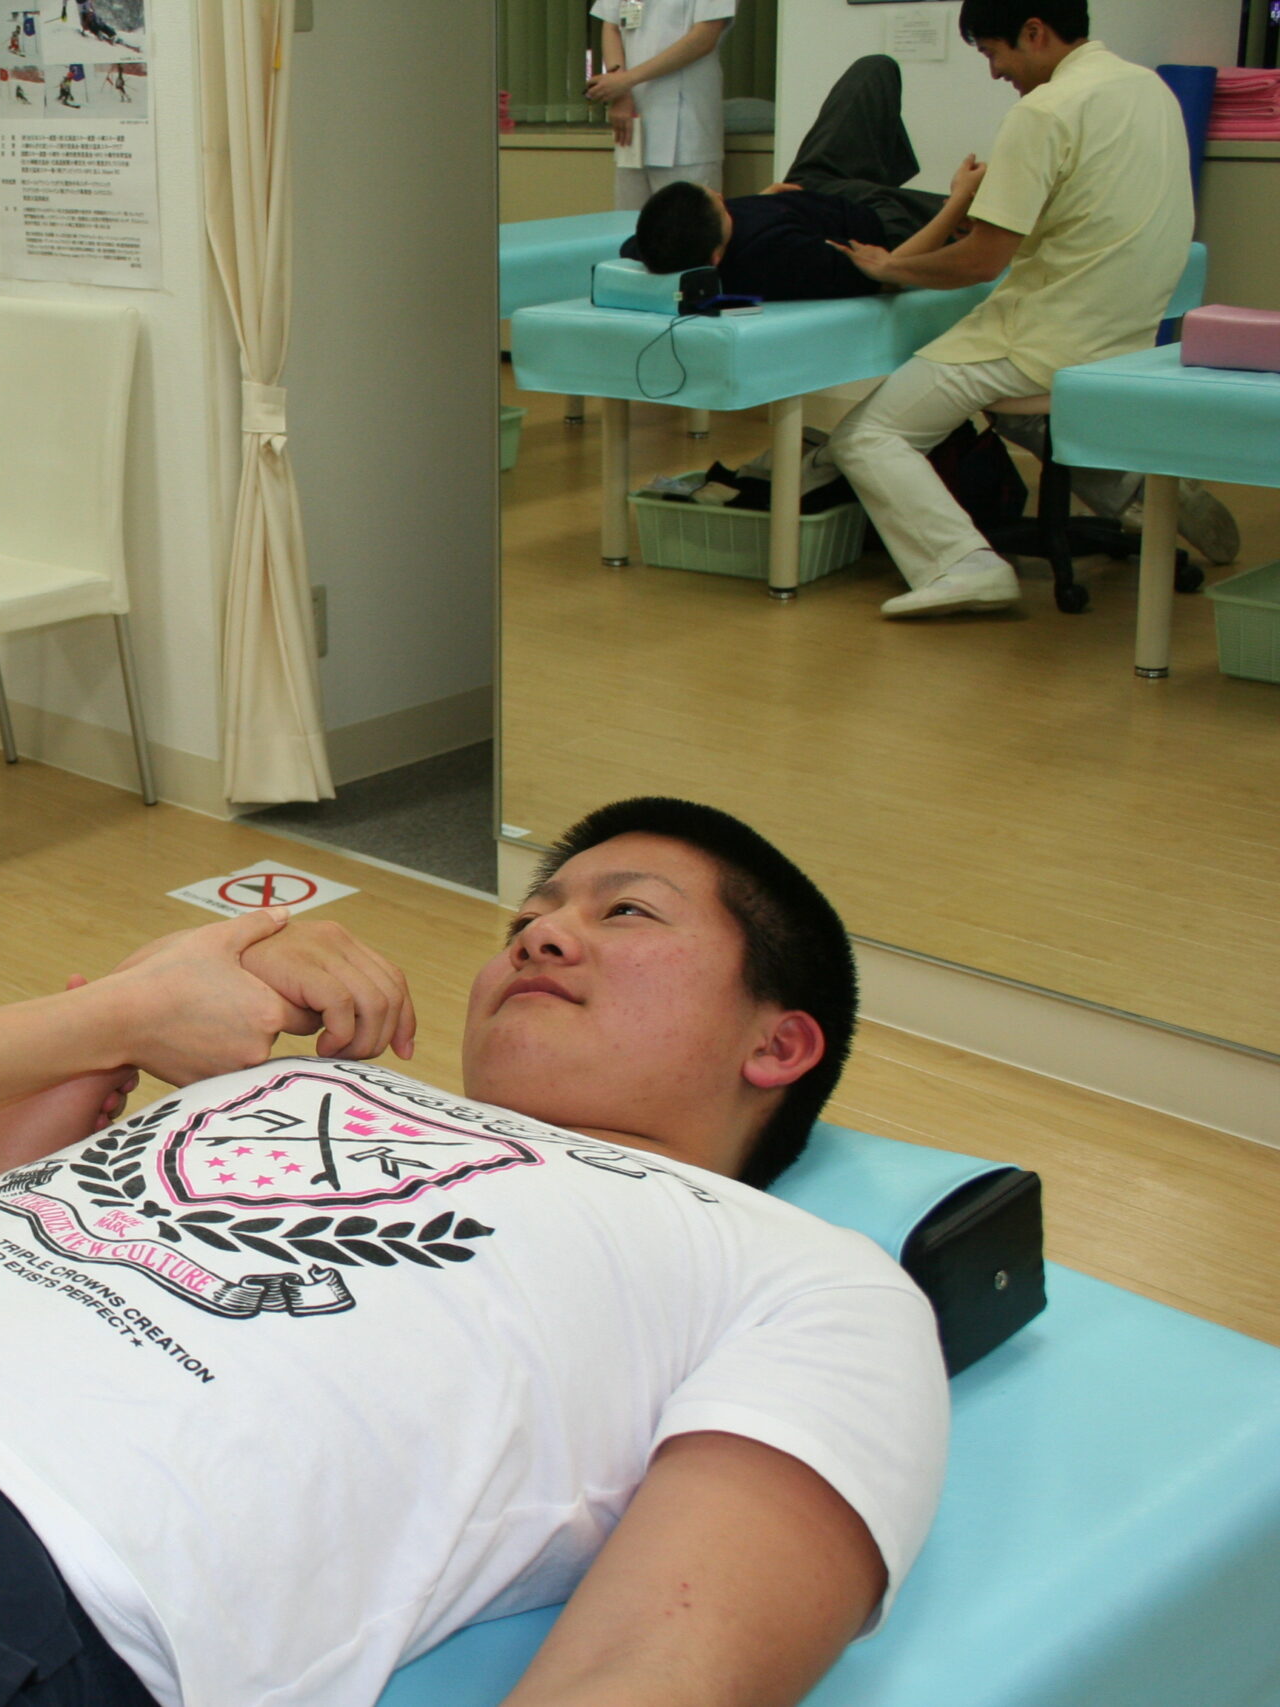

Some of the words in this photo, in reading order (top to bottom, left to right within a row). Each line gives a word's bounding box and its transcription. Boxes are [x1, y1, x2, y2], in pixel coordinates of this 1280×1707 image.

[10, 1193, 75, 1234] HYBRIDIZE
[56, 1231, 110, 1257] NEW
[111, 1243, 221, 1294] CULTURE
[93, 1216, 131, 1238] MARK
[3, 1260, 61, 1288] EXISTS
[57, 1284, 136, 1336] PERFECT
[50, 1266, 126, 1307] CROWNS
[122, 1308, 215, 1383] CREATION
